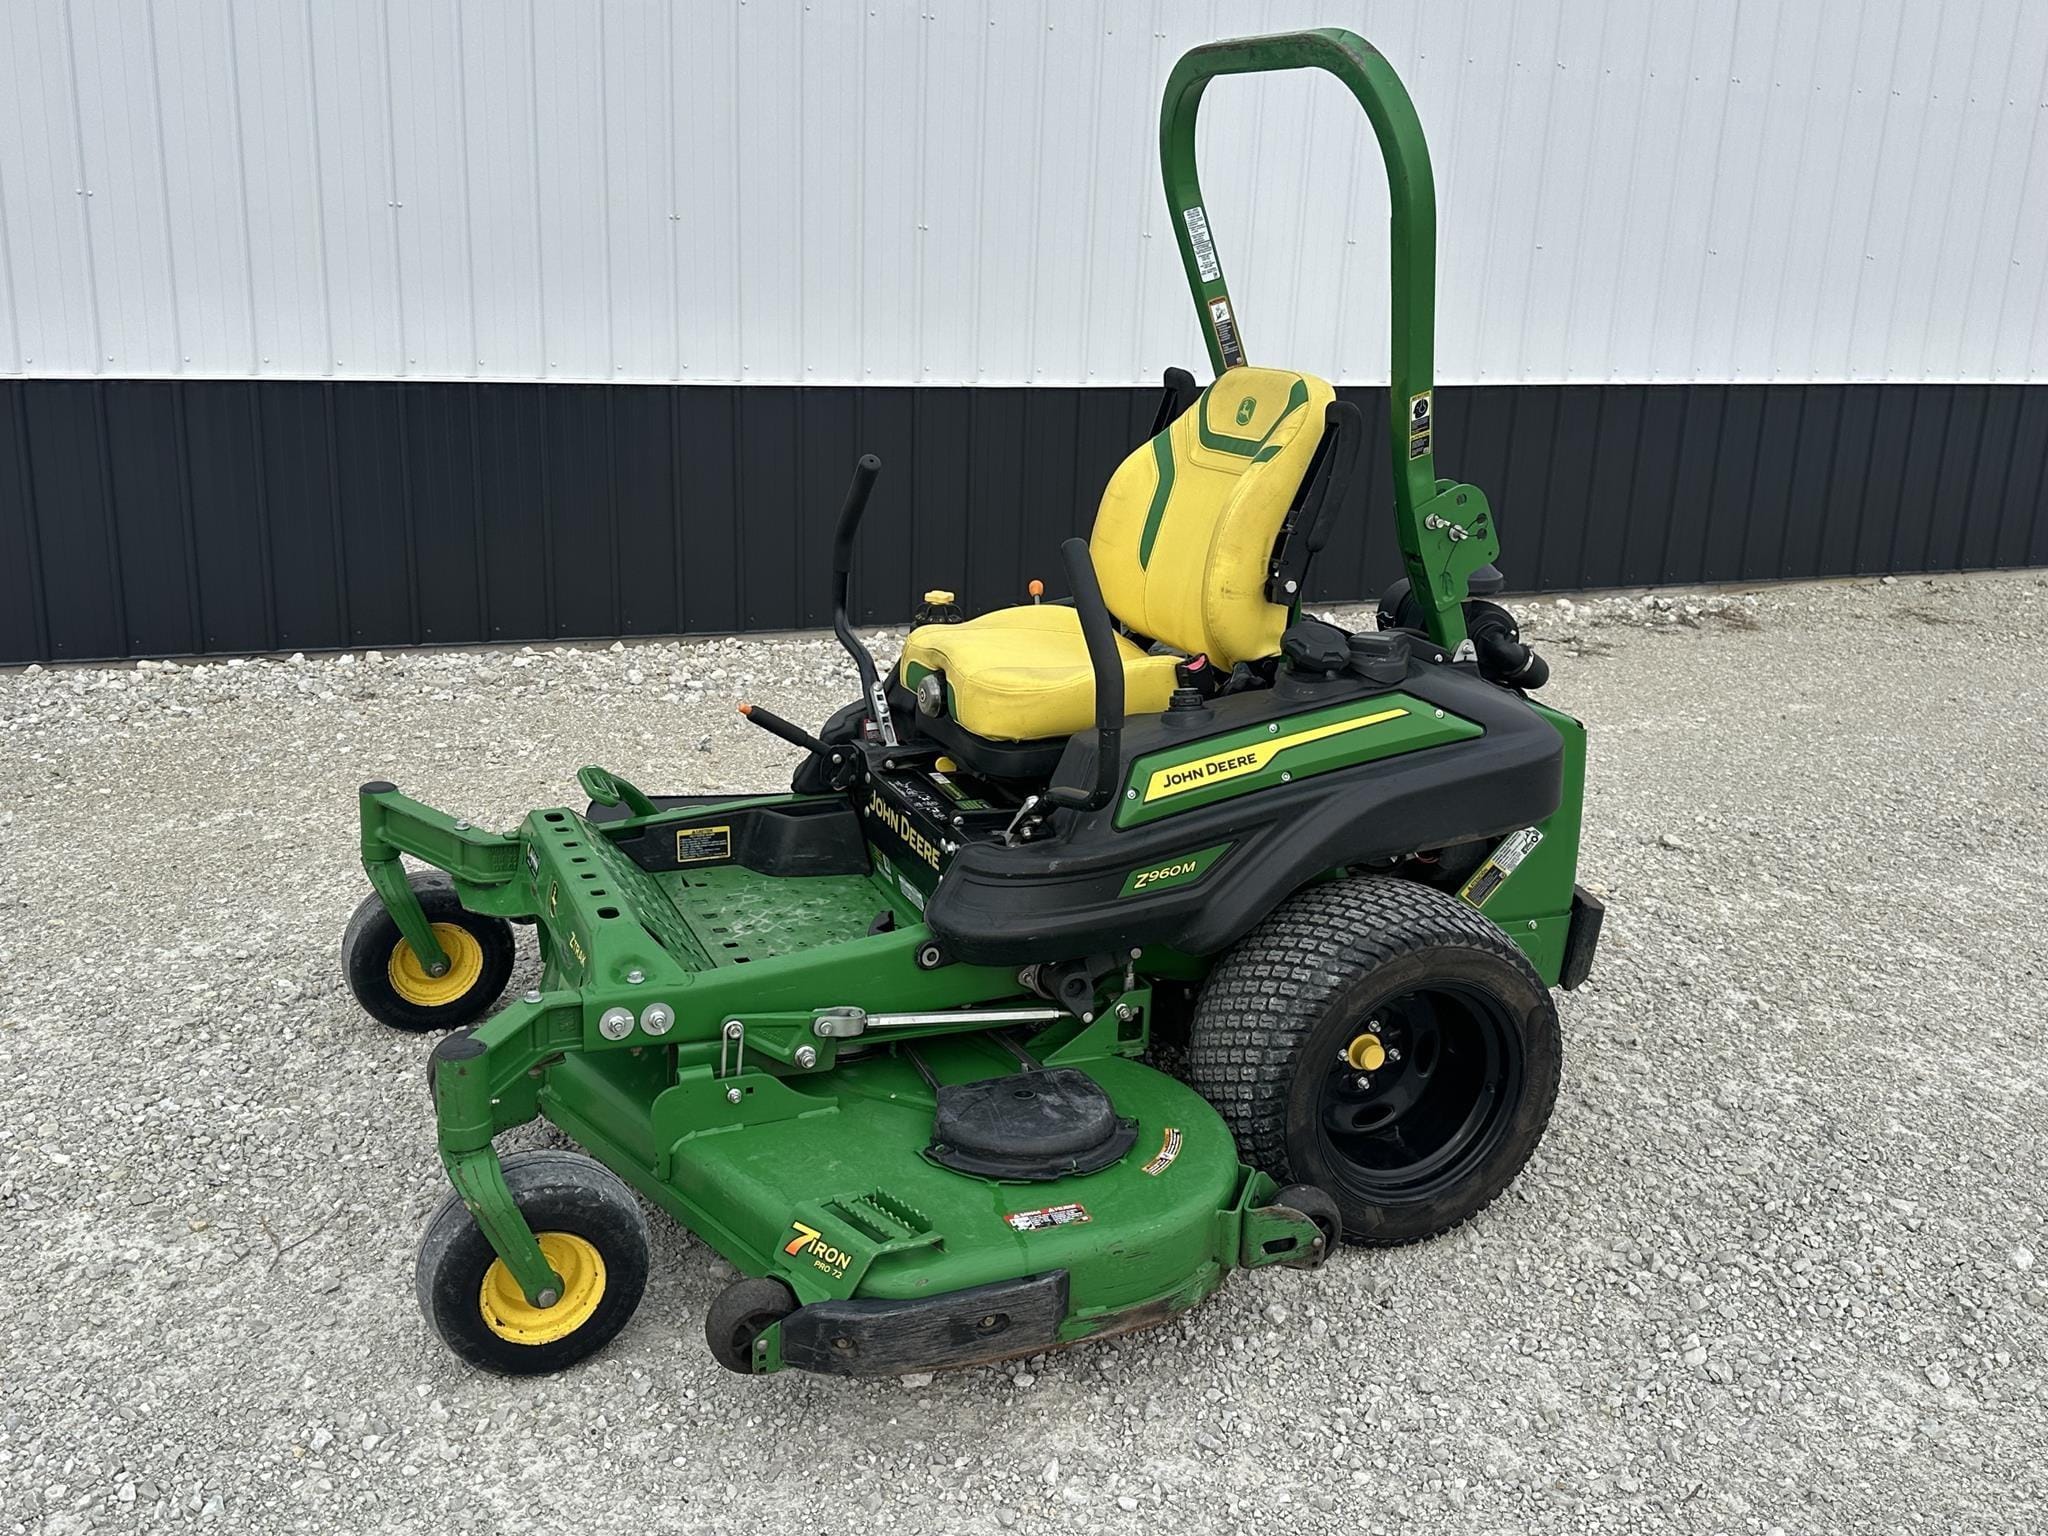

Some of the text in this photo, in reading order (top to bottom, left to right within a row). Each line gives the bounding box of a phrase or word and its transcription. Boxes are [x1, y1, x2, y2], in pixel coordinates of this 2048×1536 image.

[1163, 752, 1257, 788] JOHN DEERE
[869, 789, 899, 834] JOHN
[900, 813, 941, 871] DEERE
[1133, 860, 1197, 889] Z960M
[813, 1259, 843, 1280] PRO 72
